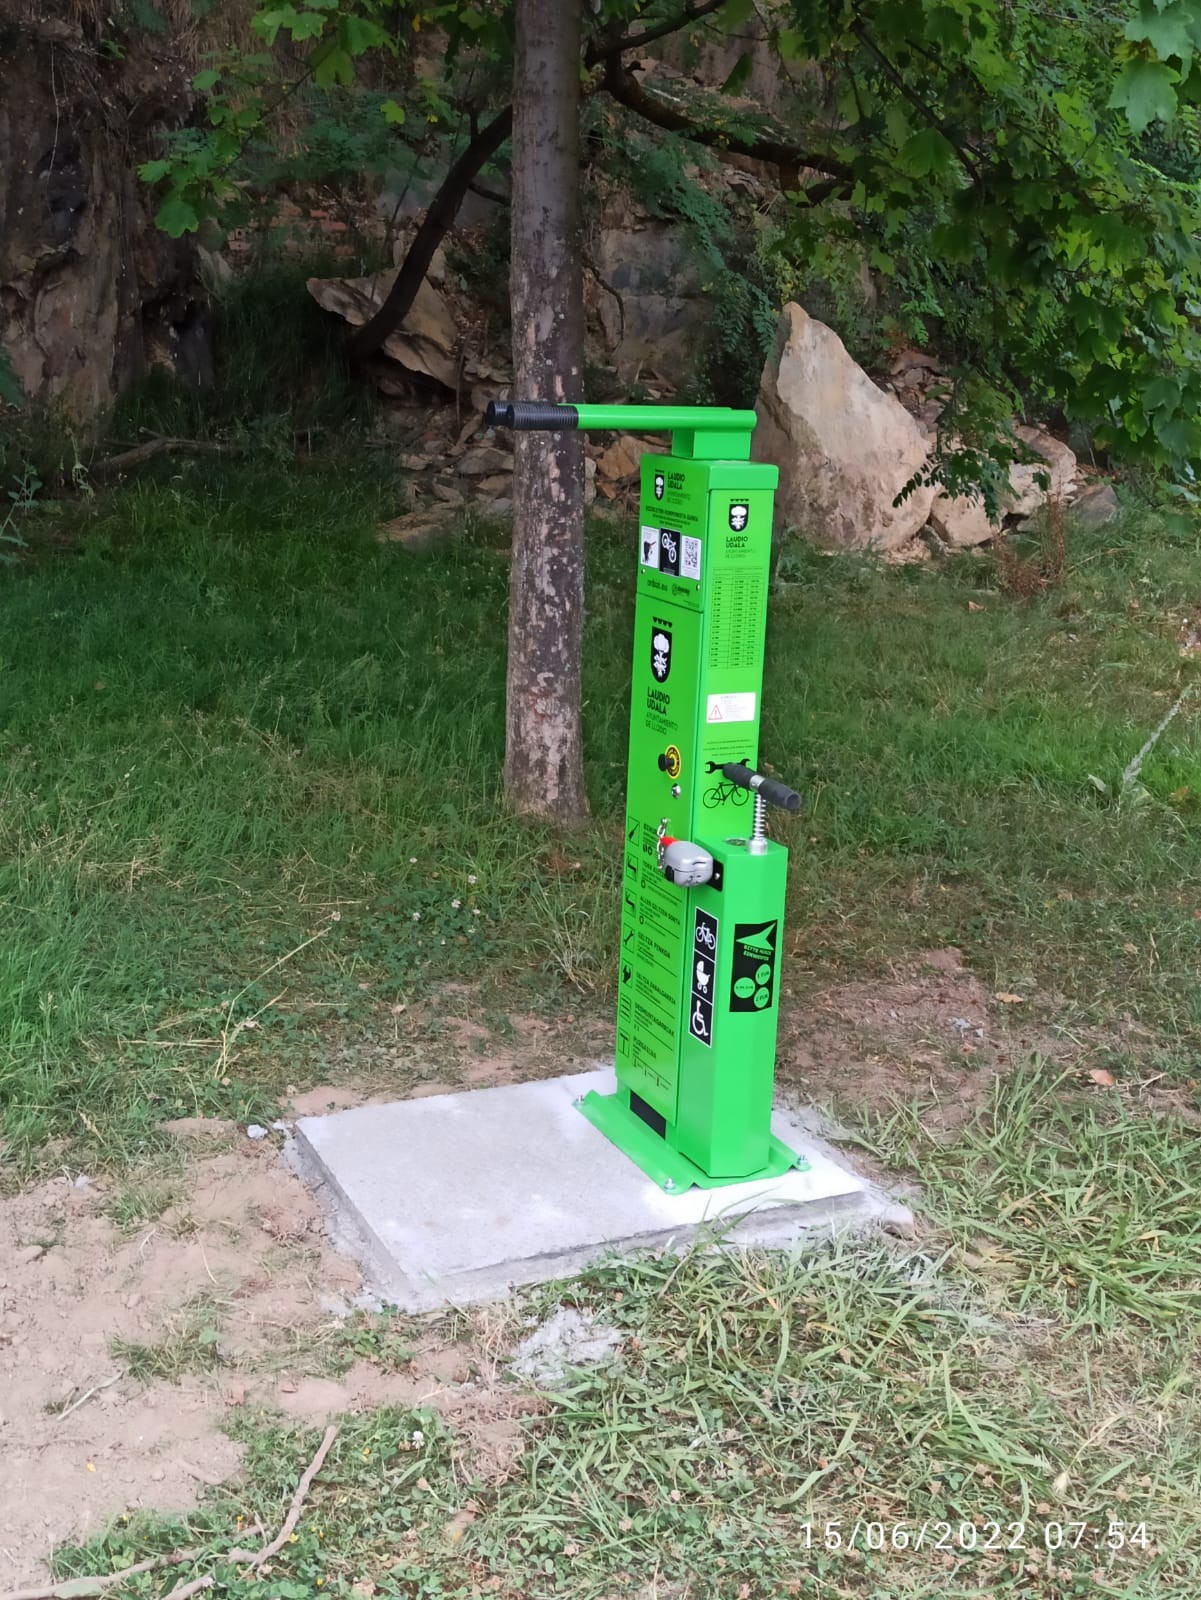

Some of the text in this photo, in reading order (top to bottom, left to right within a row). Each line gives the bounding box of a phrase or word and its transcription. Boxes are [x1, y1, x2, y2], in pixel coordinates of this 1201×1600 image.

[667, 471, 686, 482] LAUDIO
[647, 686, 671, 705] LAUDIO
[646, 697, 667, 716] UDALA
